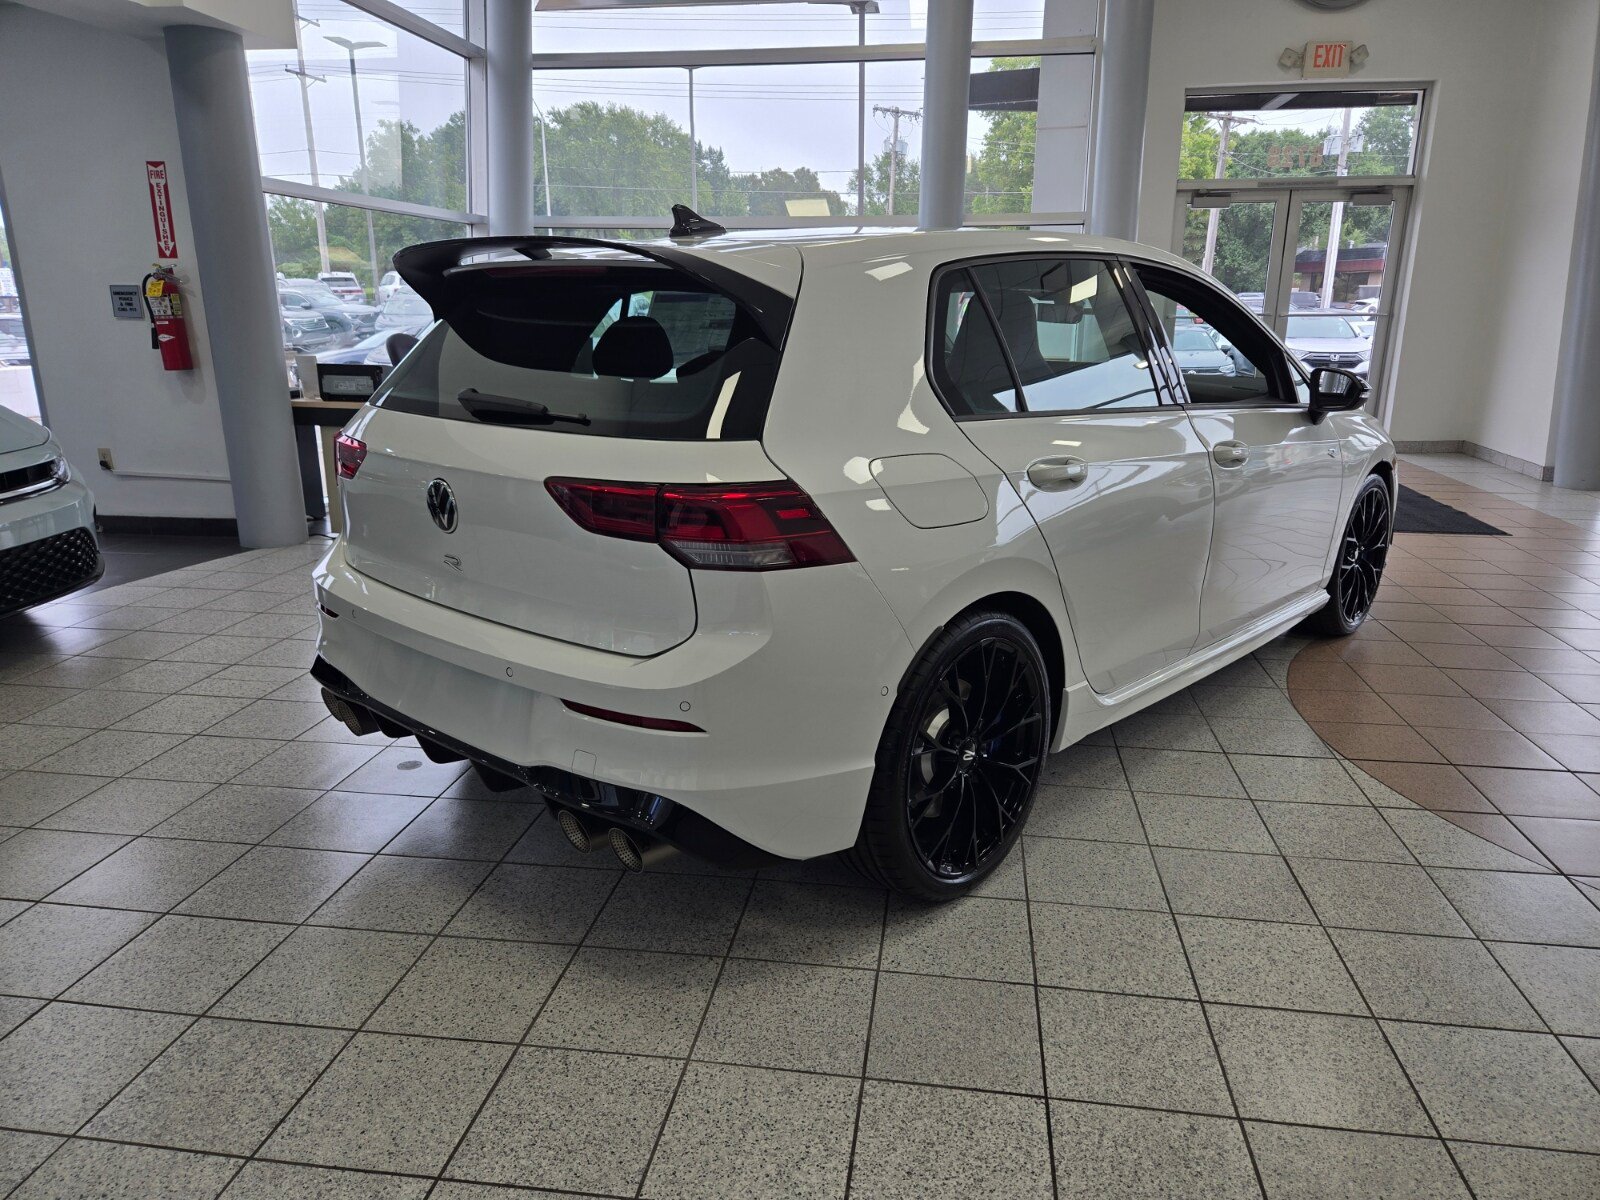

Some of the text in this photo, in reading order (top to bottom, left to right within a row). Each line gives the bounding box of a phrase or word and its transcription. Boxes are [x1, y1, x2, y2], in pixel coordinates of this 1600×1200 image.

[1313, 44, 1346, 68] EXIT
[150, 169, 165, 180] FIRE
[156, 183, 170, 251] EXTINGUISHER
